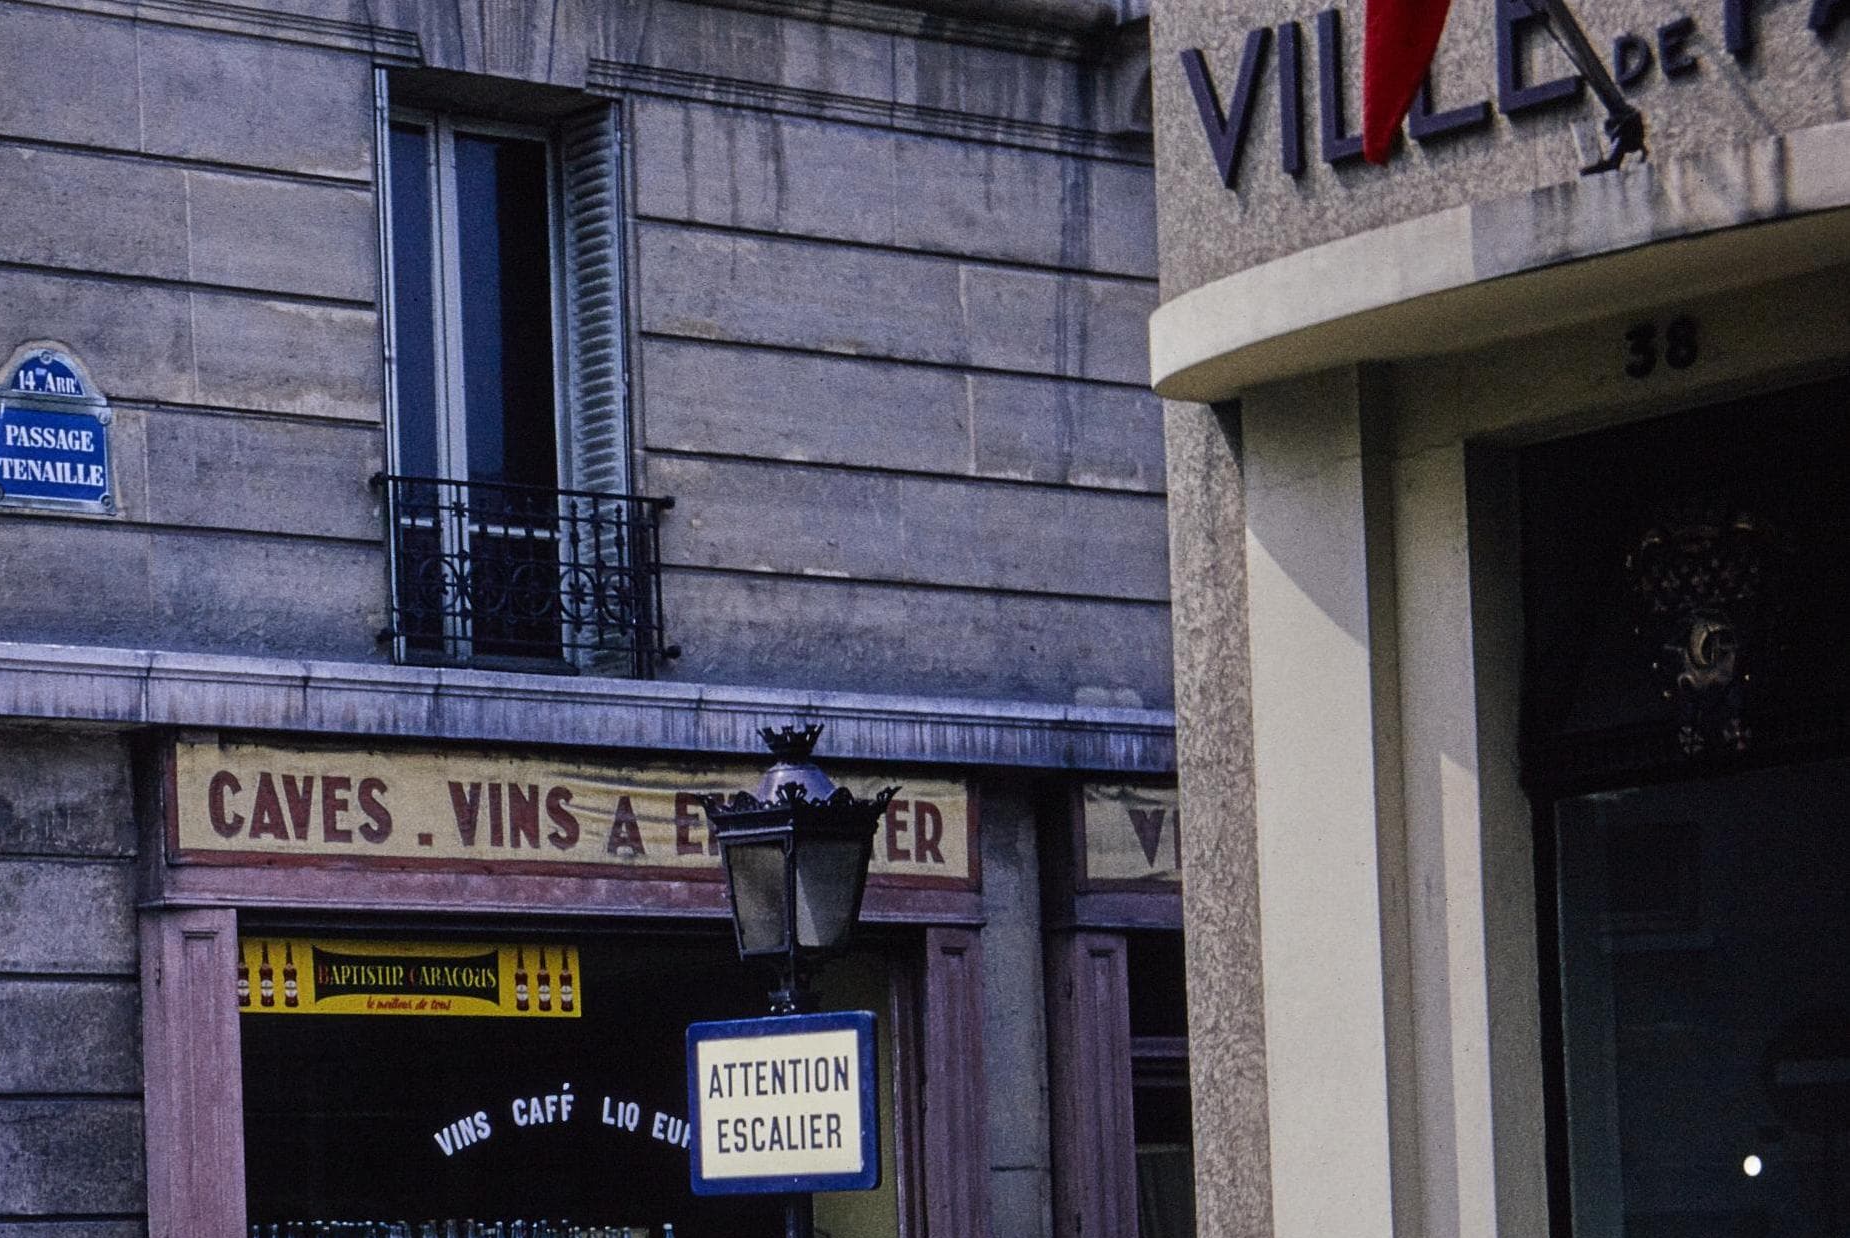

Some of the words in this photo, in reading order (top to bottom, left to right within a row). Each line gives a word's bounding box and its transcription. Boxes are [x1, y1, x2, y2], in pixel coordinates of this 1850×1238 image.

[1613, 16, 1698, 86] DE
[1624, 313, 1698, 378] 38
[5, 424, 94, 452] PASSAGE
[0, 457, 104, 487] TENAILLE
[208, 769, 393, 844] CAVES
[448, 781, 581, 850] VINS
[607, 795, 646, 855] A
[709, 1056, 849, 1099] ATTENTION
[434, 1111, 491, 1157] VINS
[718, 1112, 842, 1154] ESCALIER
